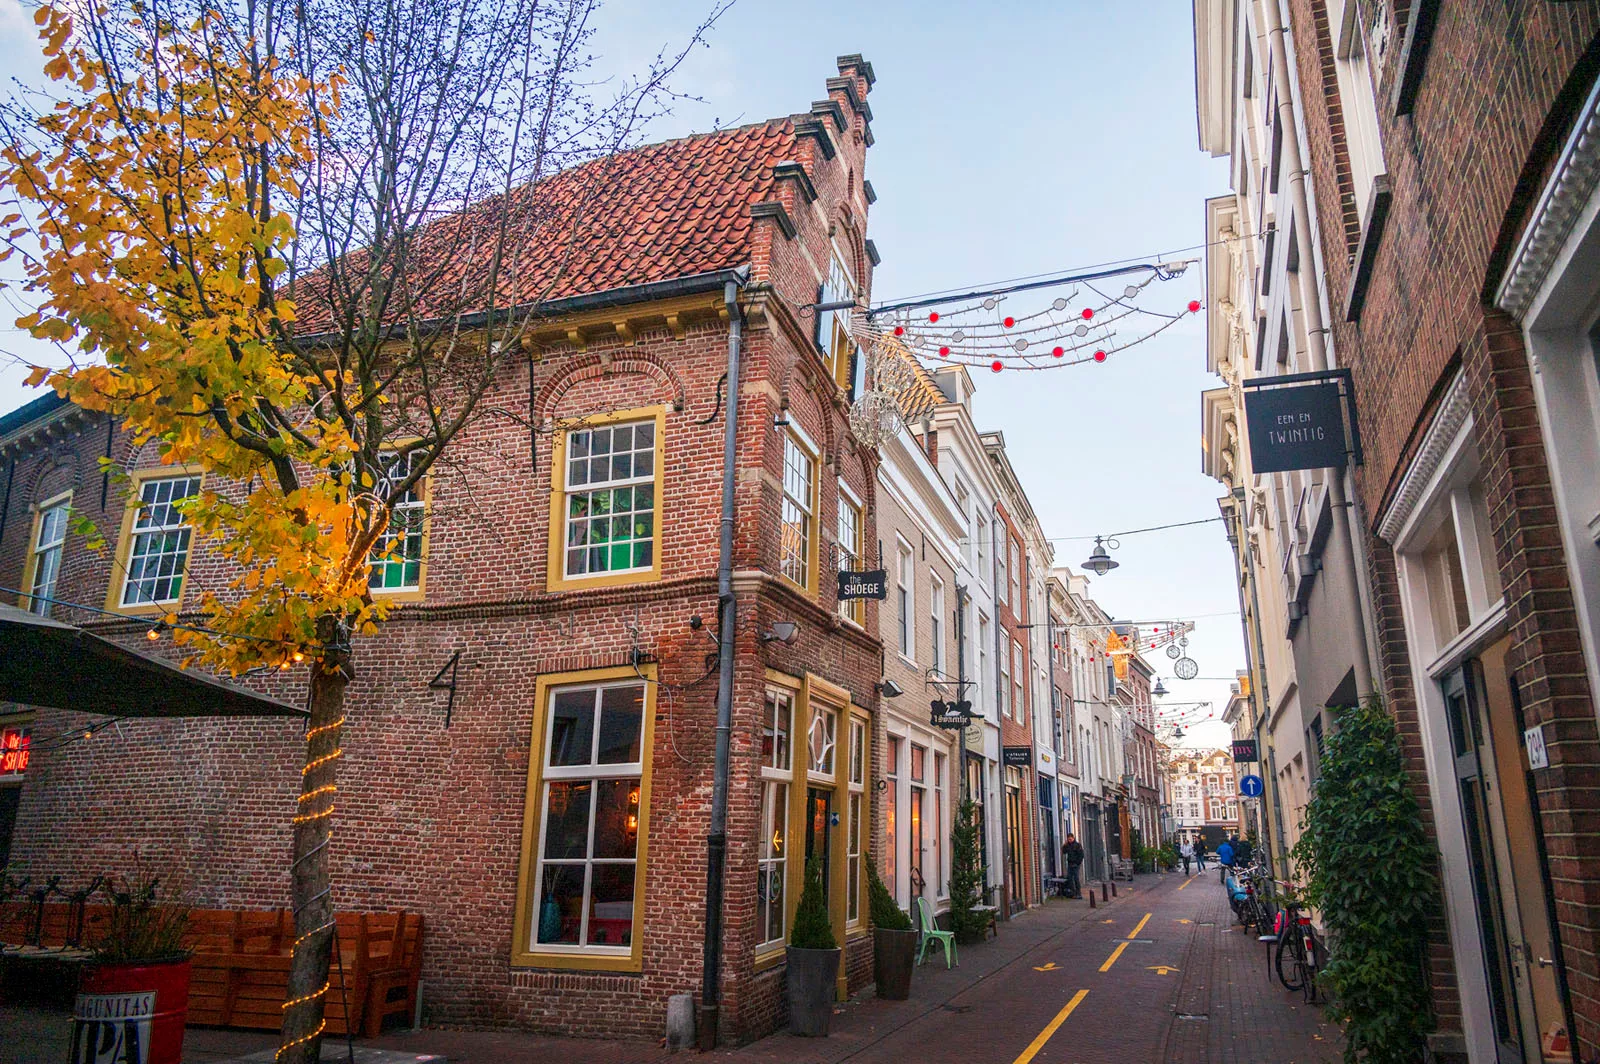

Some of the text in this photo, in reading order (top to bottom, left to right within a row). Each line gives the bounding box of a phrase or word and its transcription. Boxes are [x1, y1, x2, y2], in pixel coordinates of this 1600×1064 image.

[1277, 412, 1311, 425] EEN EN
[1269, 426, 1324, 445] TWINTIG
[849, 574, 862, 584] the
[844, 582, 879, 595] SHOEGE
[1528, 732, 1543, 765] 29A
